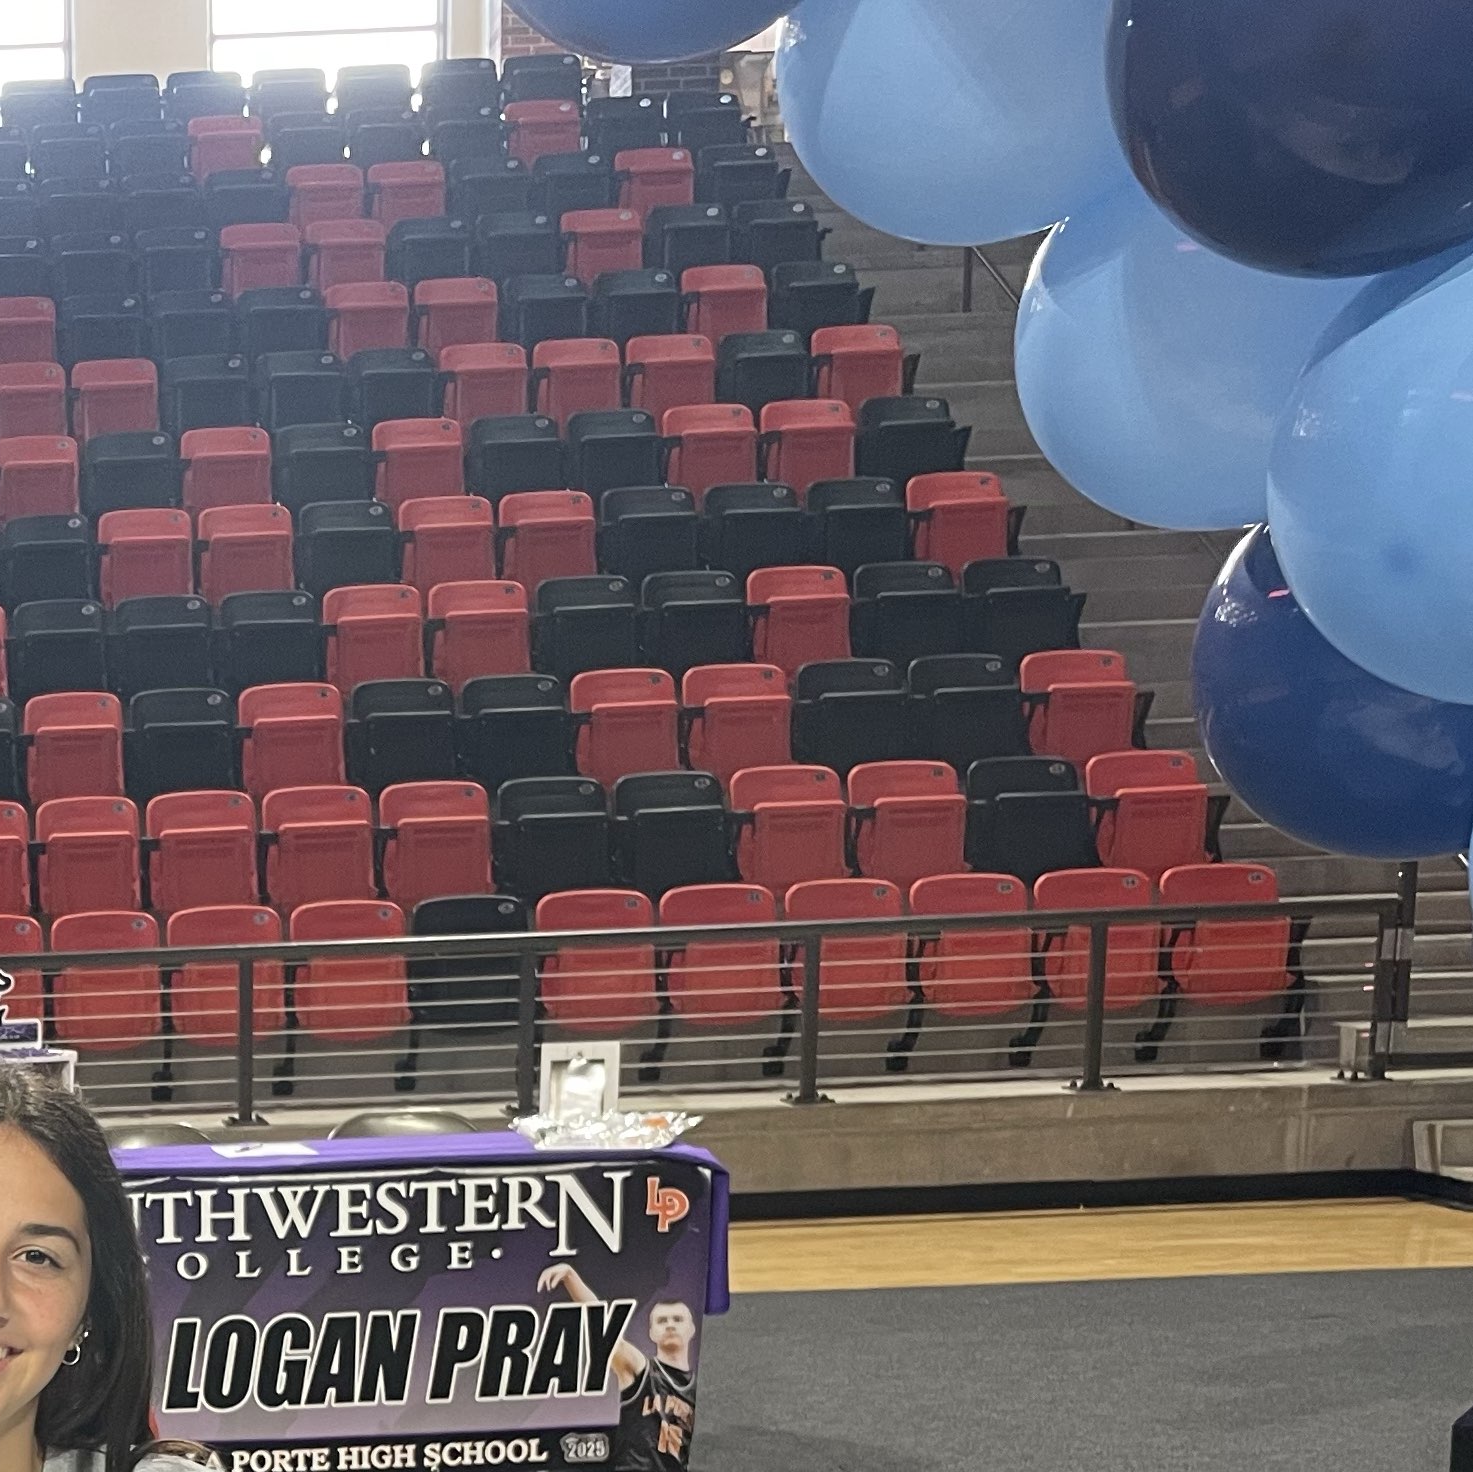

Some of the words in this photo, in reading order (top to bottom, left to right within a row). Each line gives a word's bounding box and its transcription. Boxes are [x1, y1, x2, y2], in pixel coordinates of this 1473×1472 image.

[142, 1241, 474, 1281] OLLEGE
[161, 1307, 419, 1413] LOGAN
[427, 1300, 637, 1402] PRAY
[336, 1443, 417, 1471] HIGH
[423, 1438, 548, 1467] SCHOOL
